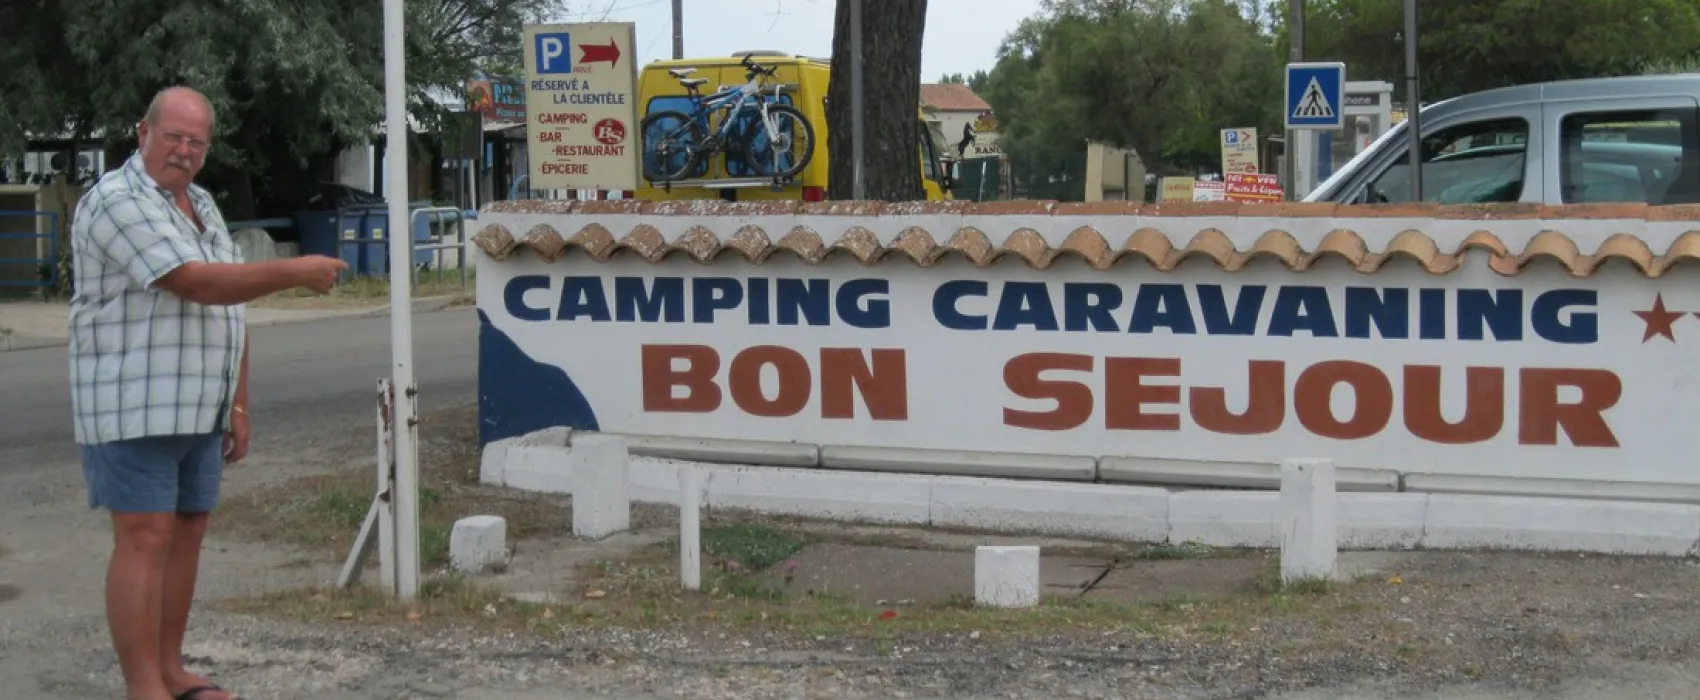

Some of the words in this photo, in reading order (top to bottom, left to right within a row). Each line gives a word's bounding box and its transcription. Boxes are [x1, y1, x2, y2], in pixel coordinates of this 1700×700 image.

[541, 38, 563, 70] P
[531, 78, 578, 91] RÉSERVÉ
[582, 81, 590, 90] A
[553, 94, 568, 104] LA
[538, 113, 587, 124] CAMPING
[540, 132, 562, 142] BAR
[556, 145, 625, 156] RESTAURANT
[542, 161, 588, 175] ÉPICERIE
[504, 275, 890, 328] CAMPING
[932, 279, 1598, 344] CARAVANING
[641, 344, 908, 421] BON
[1003, 351, 1622, 448] SEJOUR
